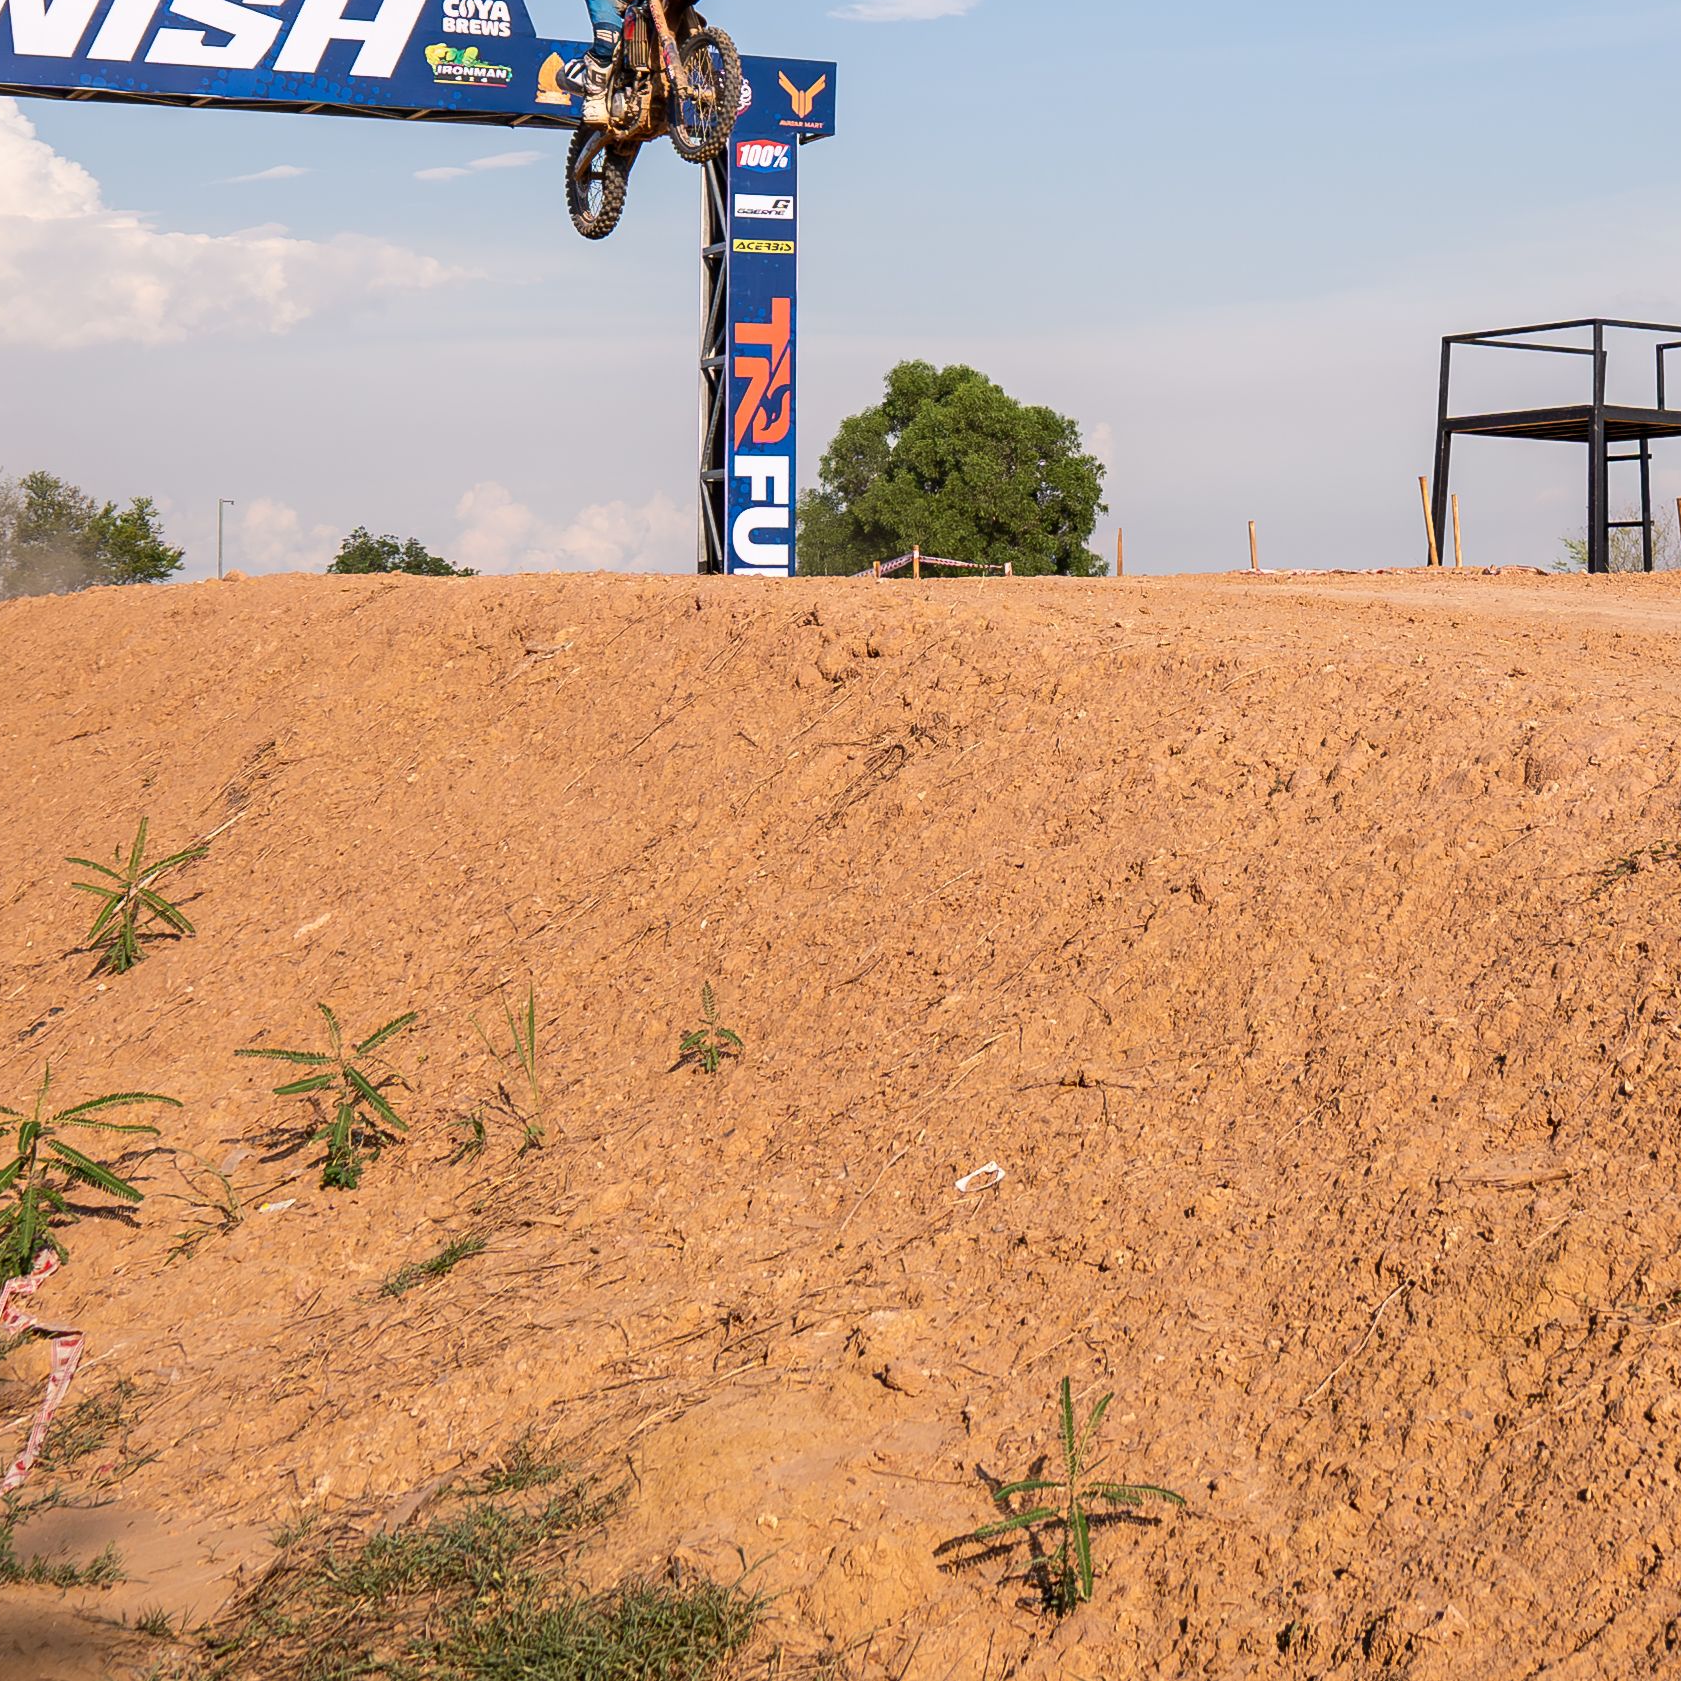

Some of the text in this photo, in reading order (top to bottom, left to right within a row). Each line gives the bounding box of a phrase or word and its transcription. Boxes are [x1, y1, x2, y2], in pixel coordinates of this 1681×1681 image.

[442, 18, 512, 37] BREWS
[437, 65, 507, 79] IRONMAN
[804, 121, 824, 129] MART
[740, 144, 790, 169] 100%
